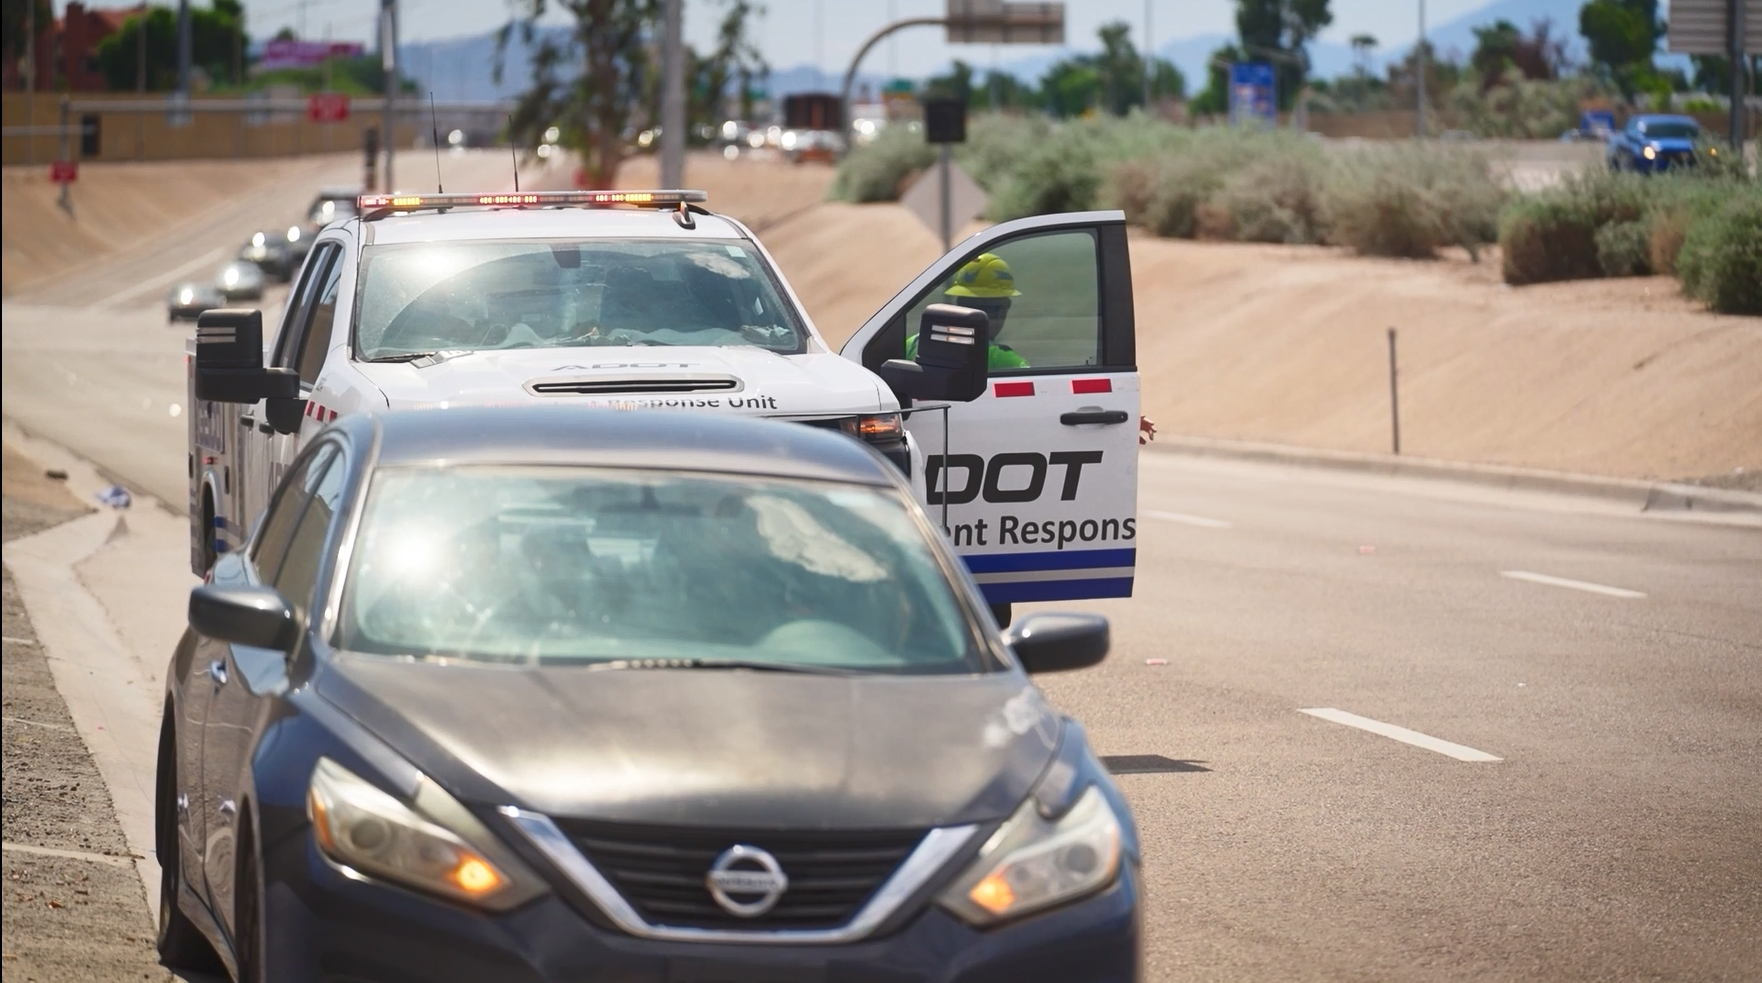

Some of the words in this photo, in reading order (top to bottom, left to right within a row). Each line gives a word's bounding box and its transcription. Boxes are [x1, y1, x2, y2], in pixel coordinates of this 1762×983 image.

[551, 362, 701, 371] ADOT
[728, 394, 778, 410] Unit
[925, 450, 1104, 505] DOT
[999, 515, 1136, 550] Respons
